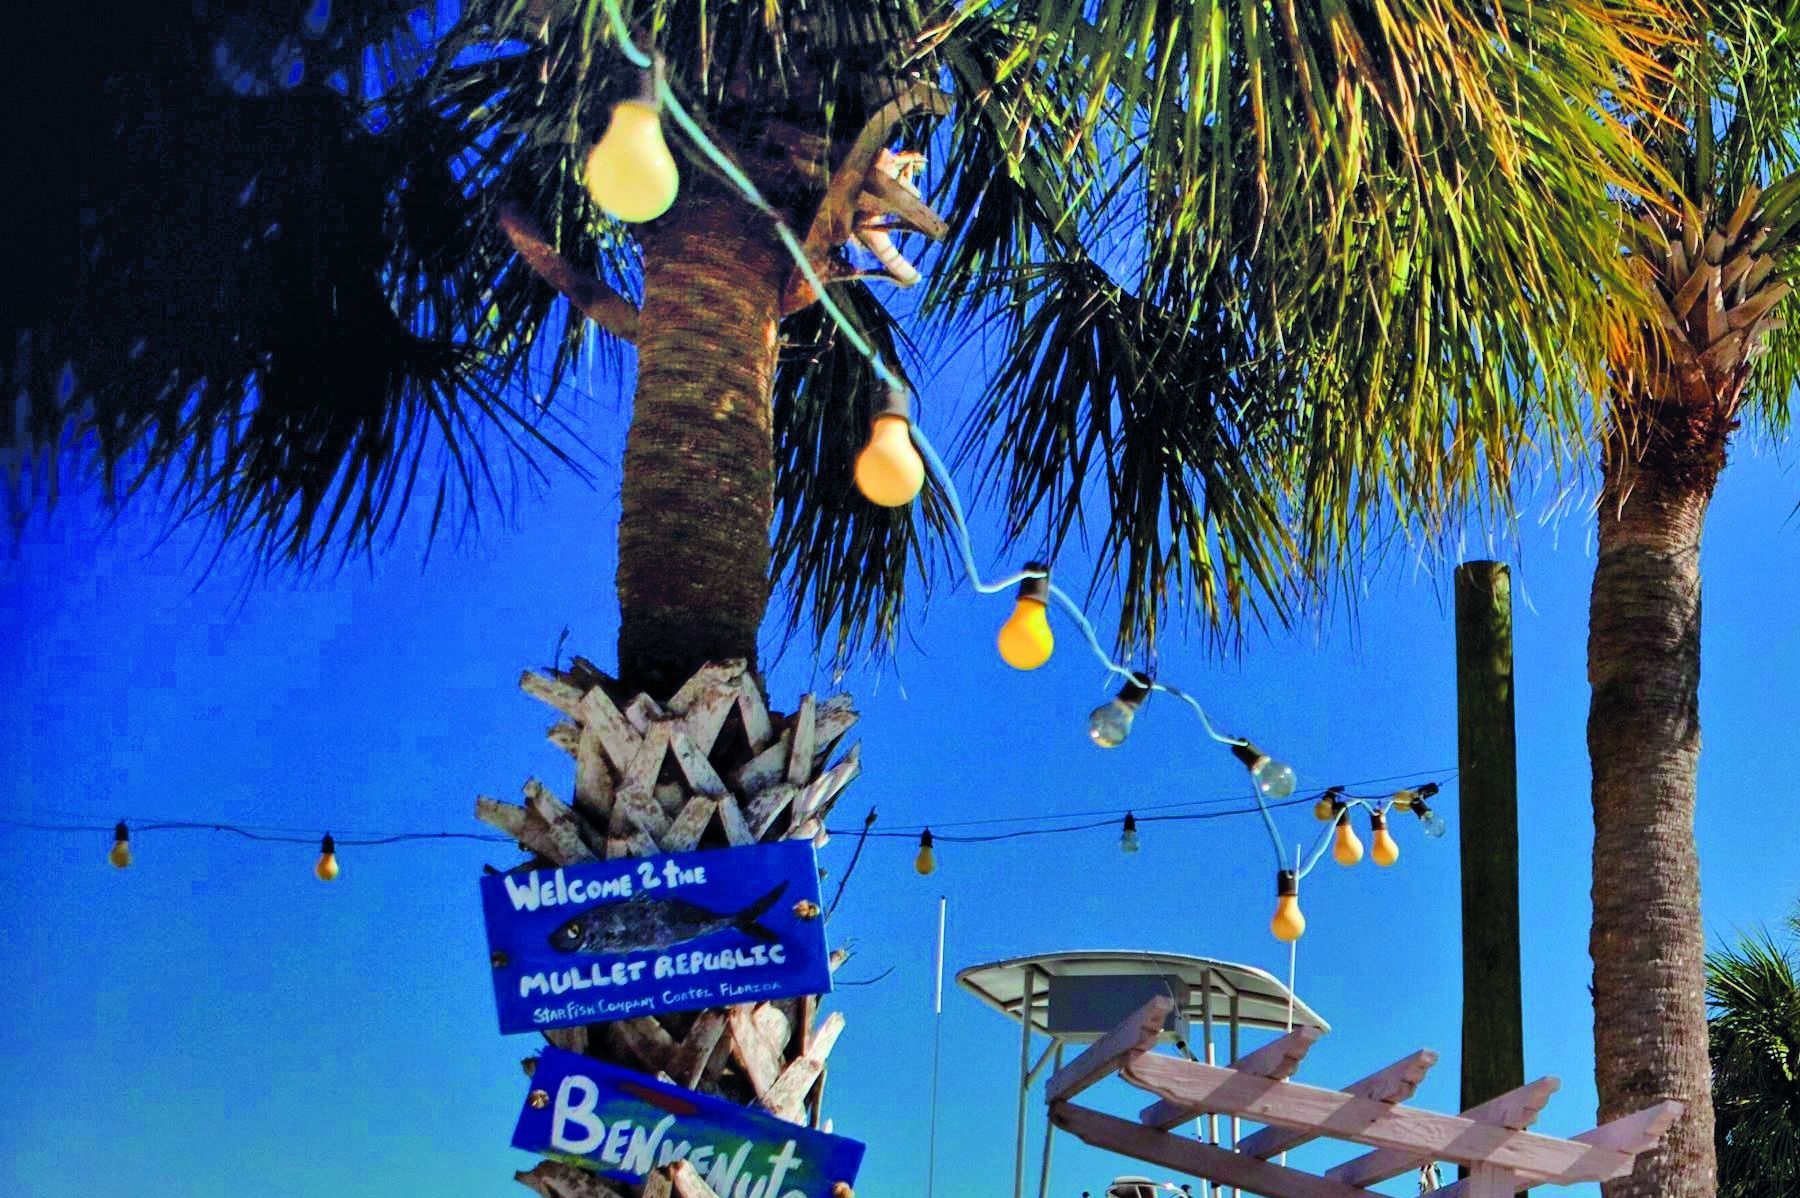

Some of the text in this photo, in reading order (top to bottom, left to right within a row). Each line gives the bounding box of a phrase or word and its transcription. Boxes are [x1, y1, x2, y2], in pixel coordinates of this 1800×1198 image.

[637, 862, 661, 889] 2
[520, 944, 787, 998] MULLET REPUBLIC
[720, 982, 781, 997] FLORIDA
